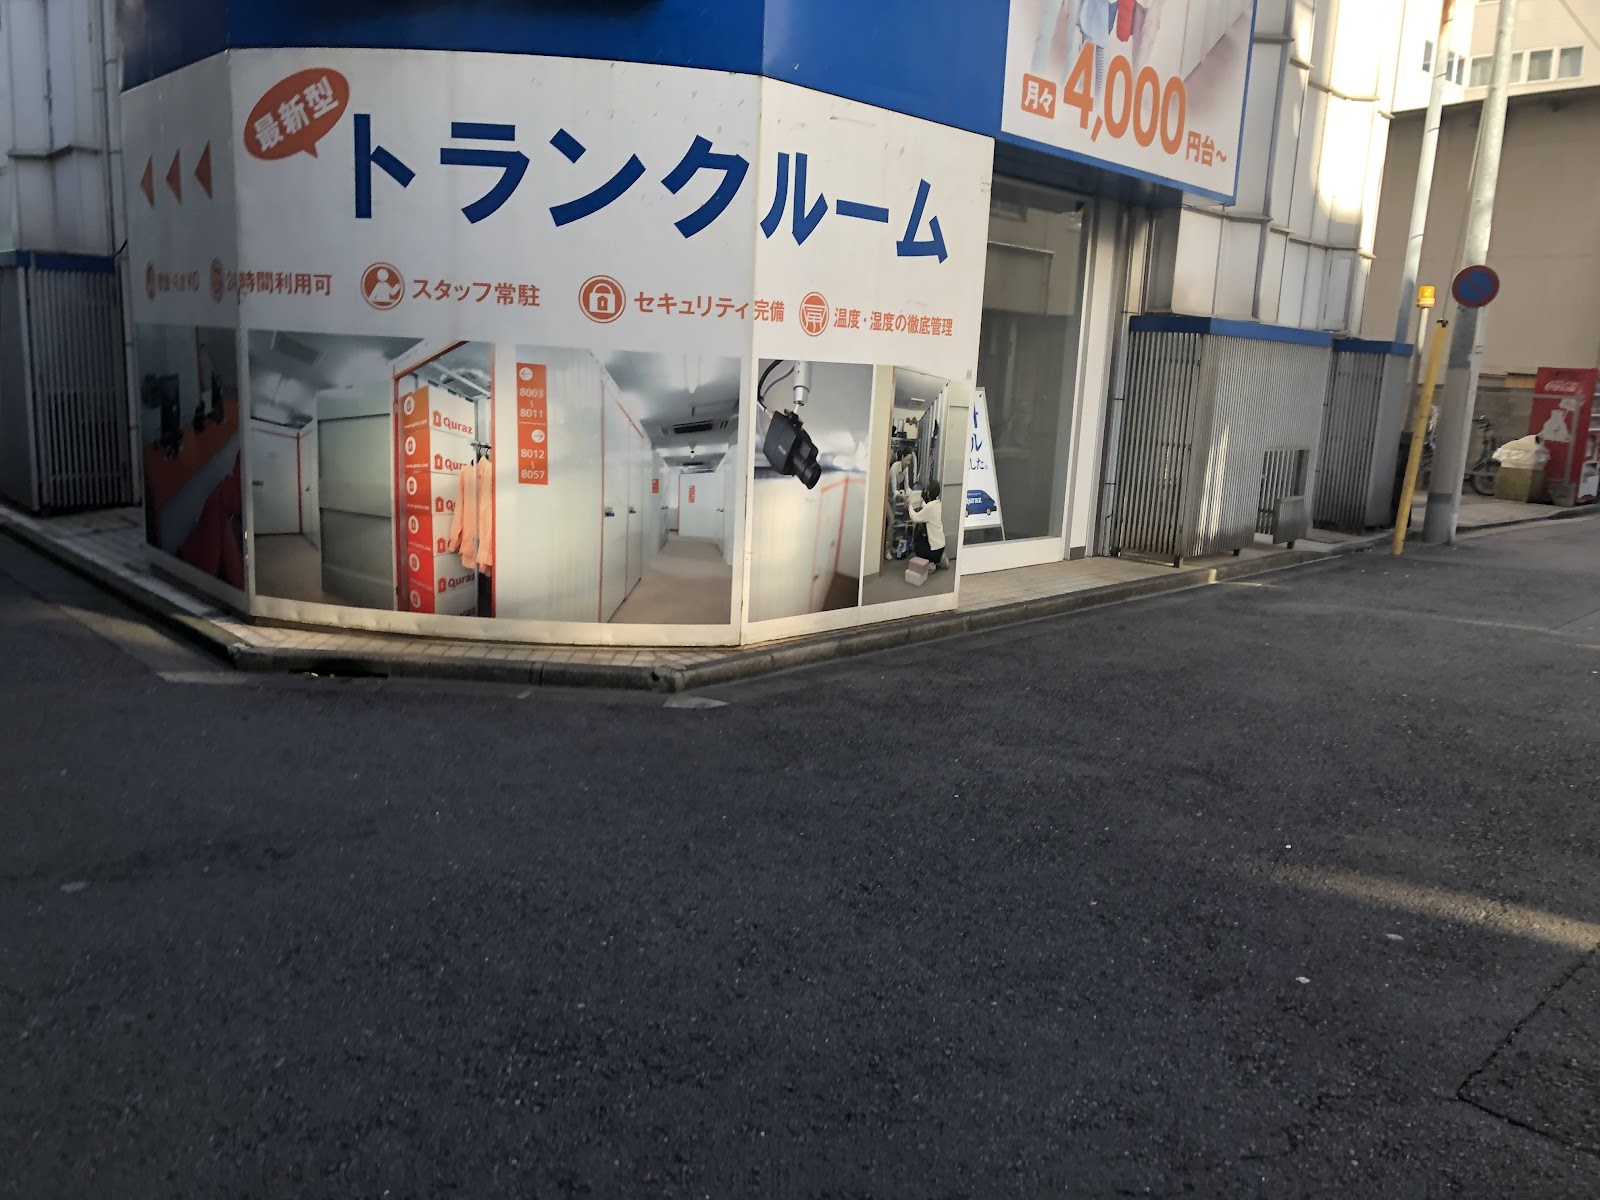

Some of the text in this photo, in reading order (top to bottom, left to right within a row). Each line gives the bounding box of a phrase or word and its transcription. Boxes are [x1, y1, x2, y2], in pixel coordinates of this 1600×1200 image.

[1024, 80, 1053, 113] 月々
[252, 76, 340, 151] 最新型
[353, 113, 949, 264] トランクルーム
[413, 277, 541, 308] スタッフ常駐
[634, 291, 785, 323] セキュリティ完備
[833, 307, 953, 337] 温度・湿度の徹底管理
[519, 387, 544, 399] 8003
[519, 408, 544, 419] 8011
[444, 417, 473, 434] Quraz
[520, 448, 545, 460] 8012
[445, 459, 467, 471] Qur
[968, 457, 989, 471] した。
[520, 469, 545, 480] 8057
